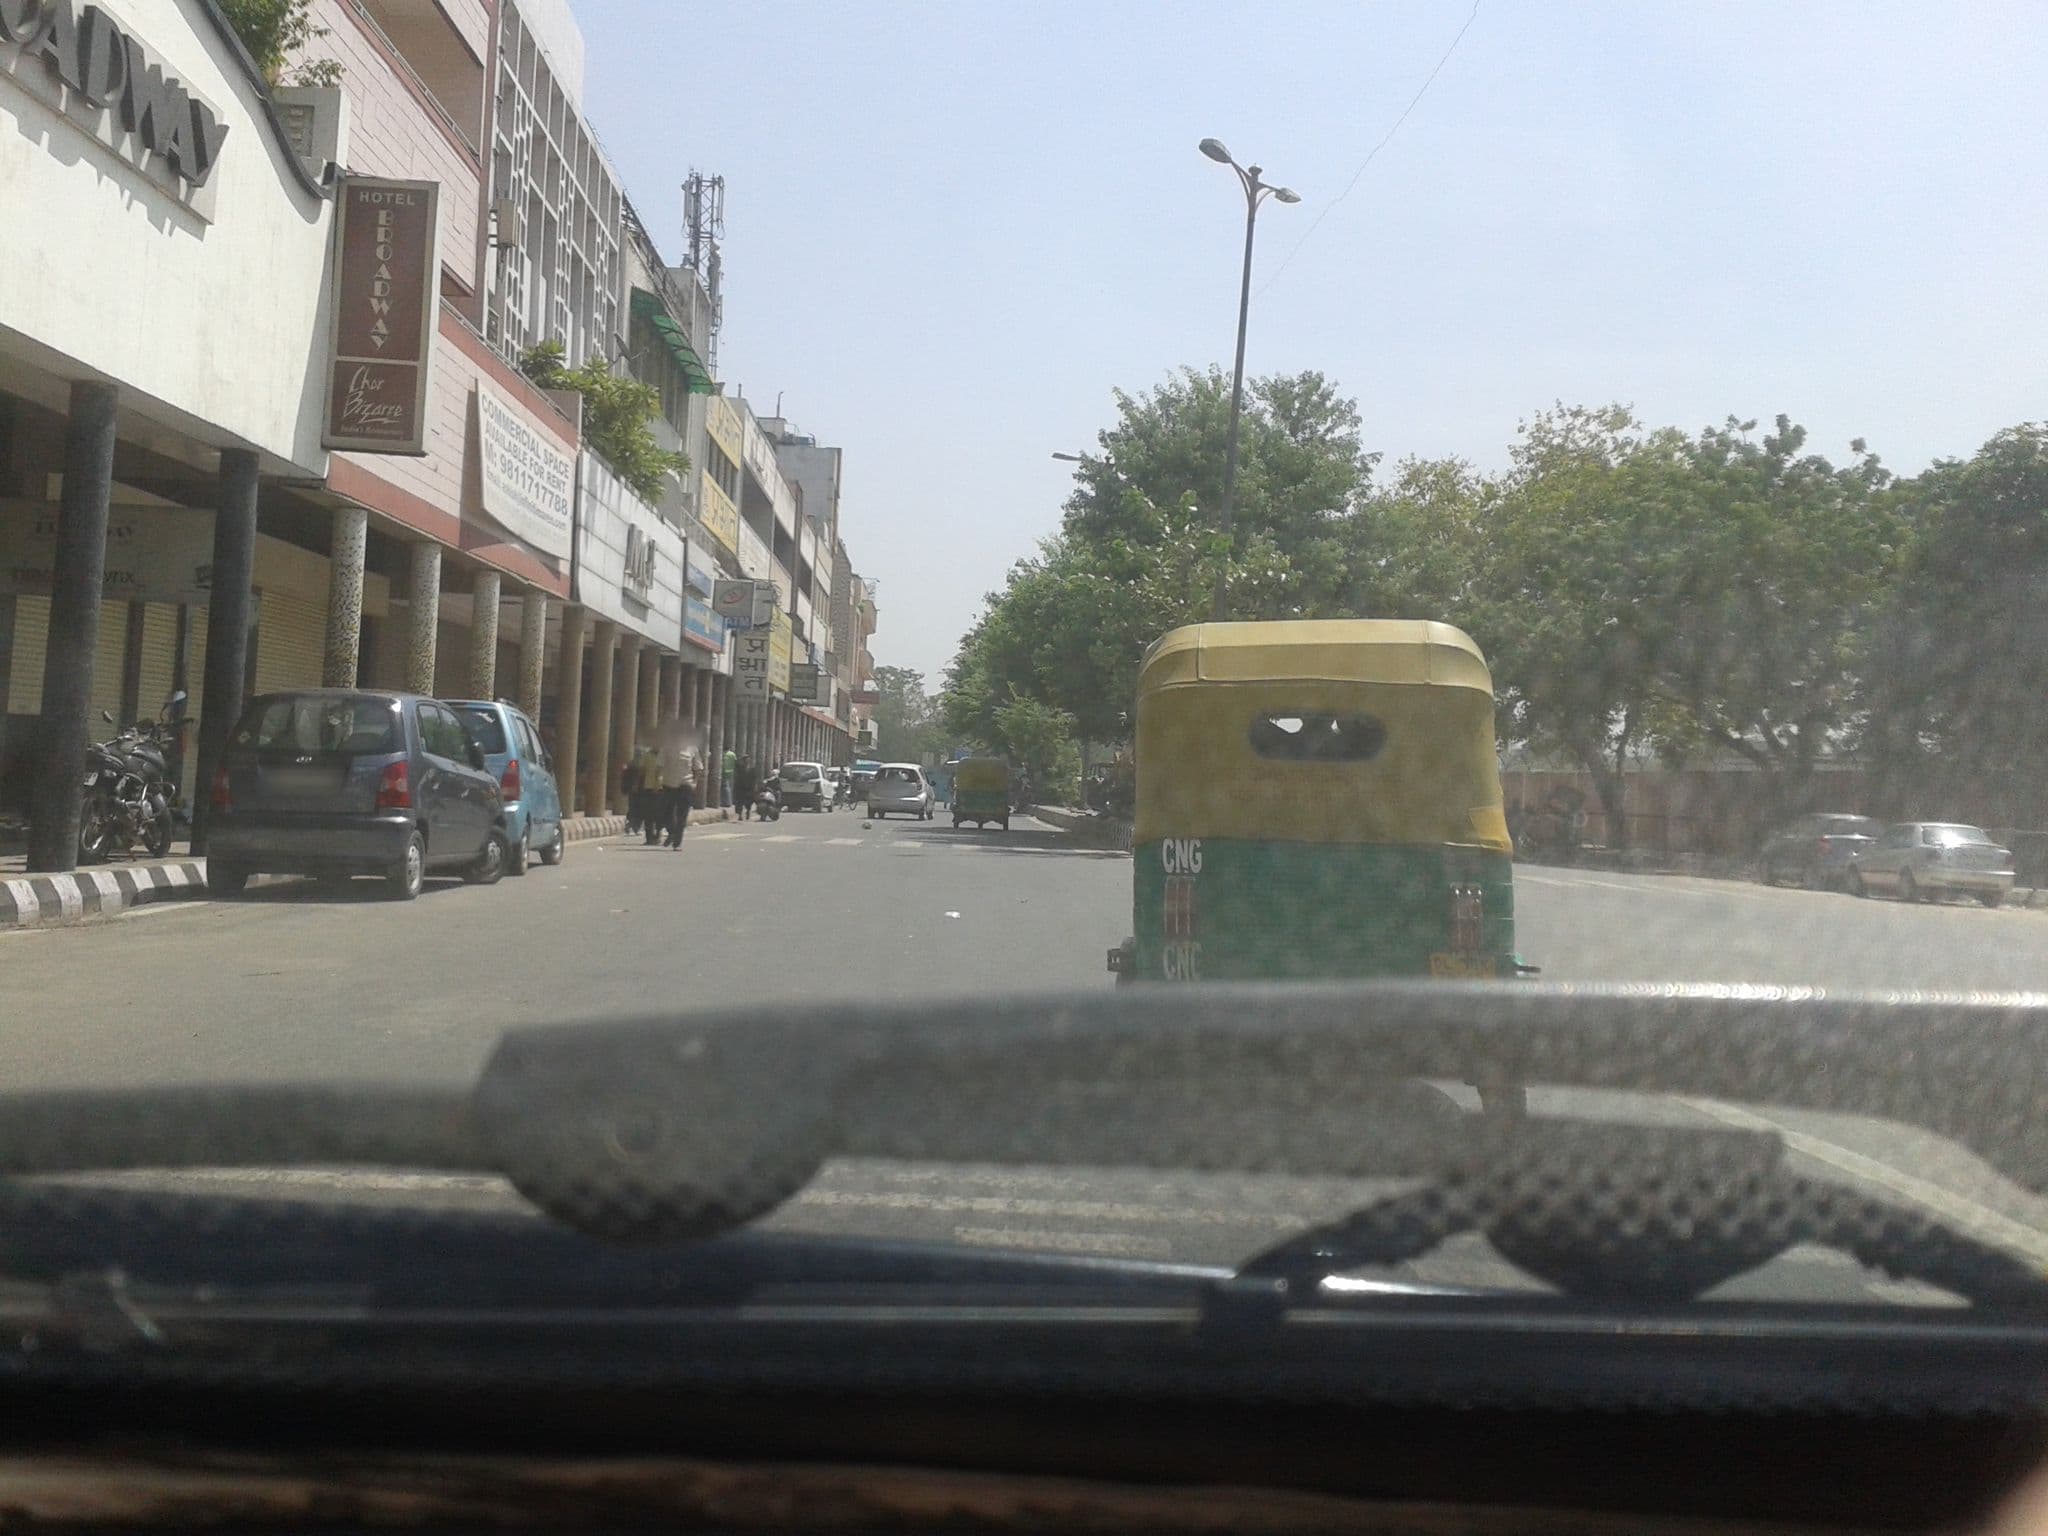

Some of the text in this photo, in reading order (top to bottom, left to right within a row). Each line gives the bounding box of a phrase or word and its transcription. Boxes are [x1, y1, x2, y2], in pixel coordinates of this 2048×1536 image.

[359, 191, 416, 206] HOTEL
[368, 209, 394, 351] BROADWAY
[348, 365, 385, 393] Chor
[343, 390, 403, 424] Bizarre
[481, 393, 569, 479] COMMERCIAL SPACE
[485, 419, 566, 494] AVAILABLE FOR RENT
[500, 453, 568, 517] 9811717788
[1162, 838, 1203, 874] CNG
